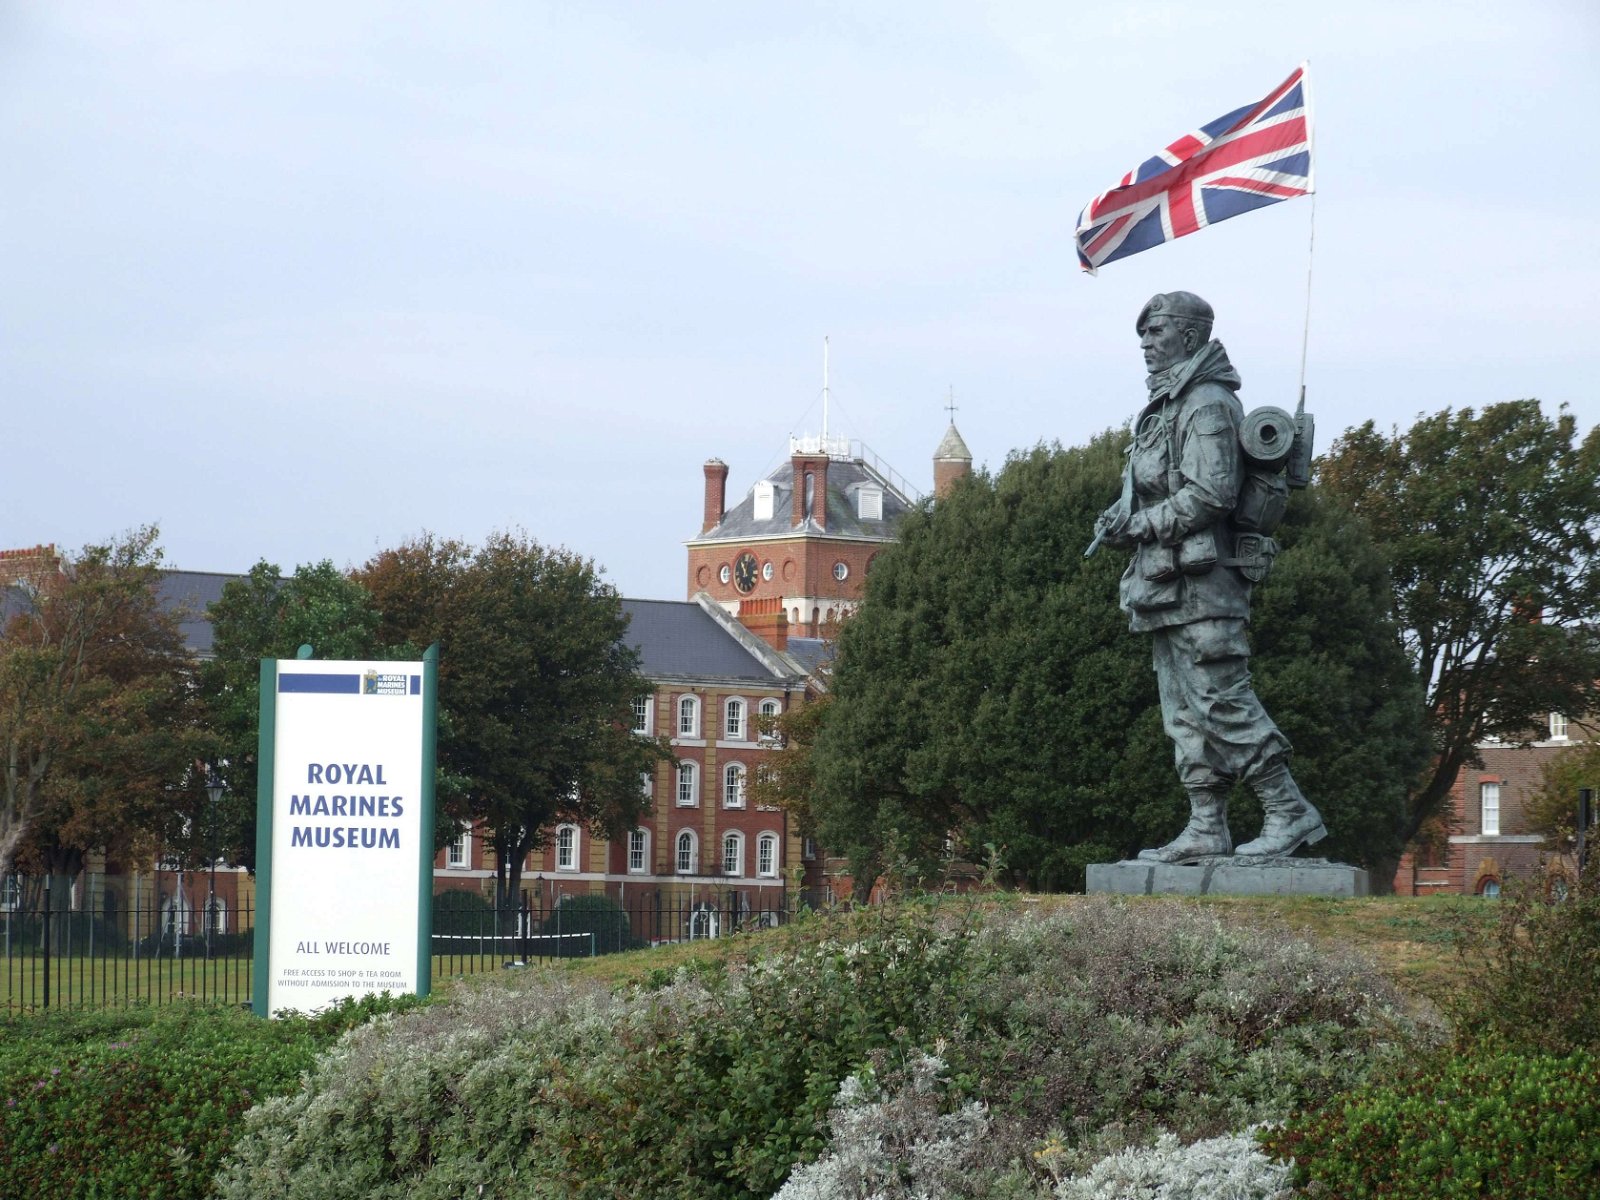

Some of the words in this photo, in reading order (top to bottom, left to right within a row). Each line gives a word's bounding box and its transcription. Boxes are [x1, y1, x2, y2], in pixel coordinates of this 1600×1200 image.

[307, 763, 387, 785] ROYAL
[289, 794, 404, 817] MARINES
[291, 826, 401, 849] MUSEUM
[296, 941, 320, 954] ALL
[325, 941, 391, 955] WELCOME
[301, 969, 325, 977] ACCESS
[328, 969, 337, 977] TO
[366, 970, 378, 978] TEA
[379, 970, 402, 978] ROOM
[277, 979, 309, 987] WITHOUT
[310, 980, 350, 988] ADMISSION
[352, 980, 361, 988] TO
[376, 981, 407, 989] MUSEUM
